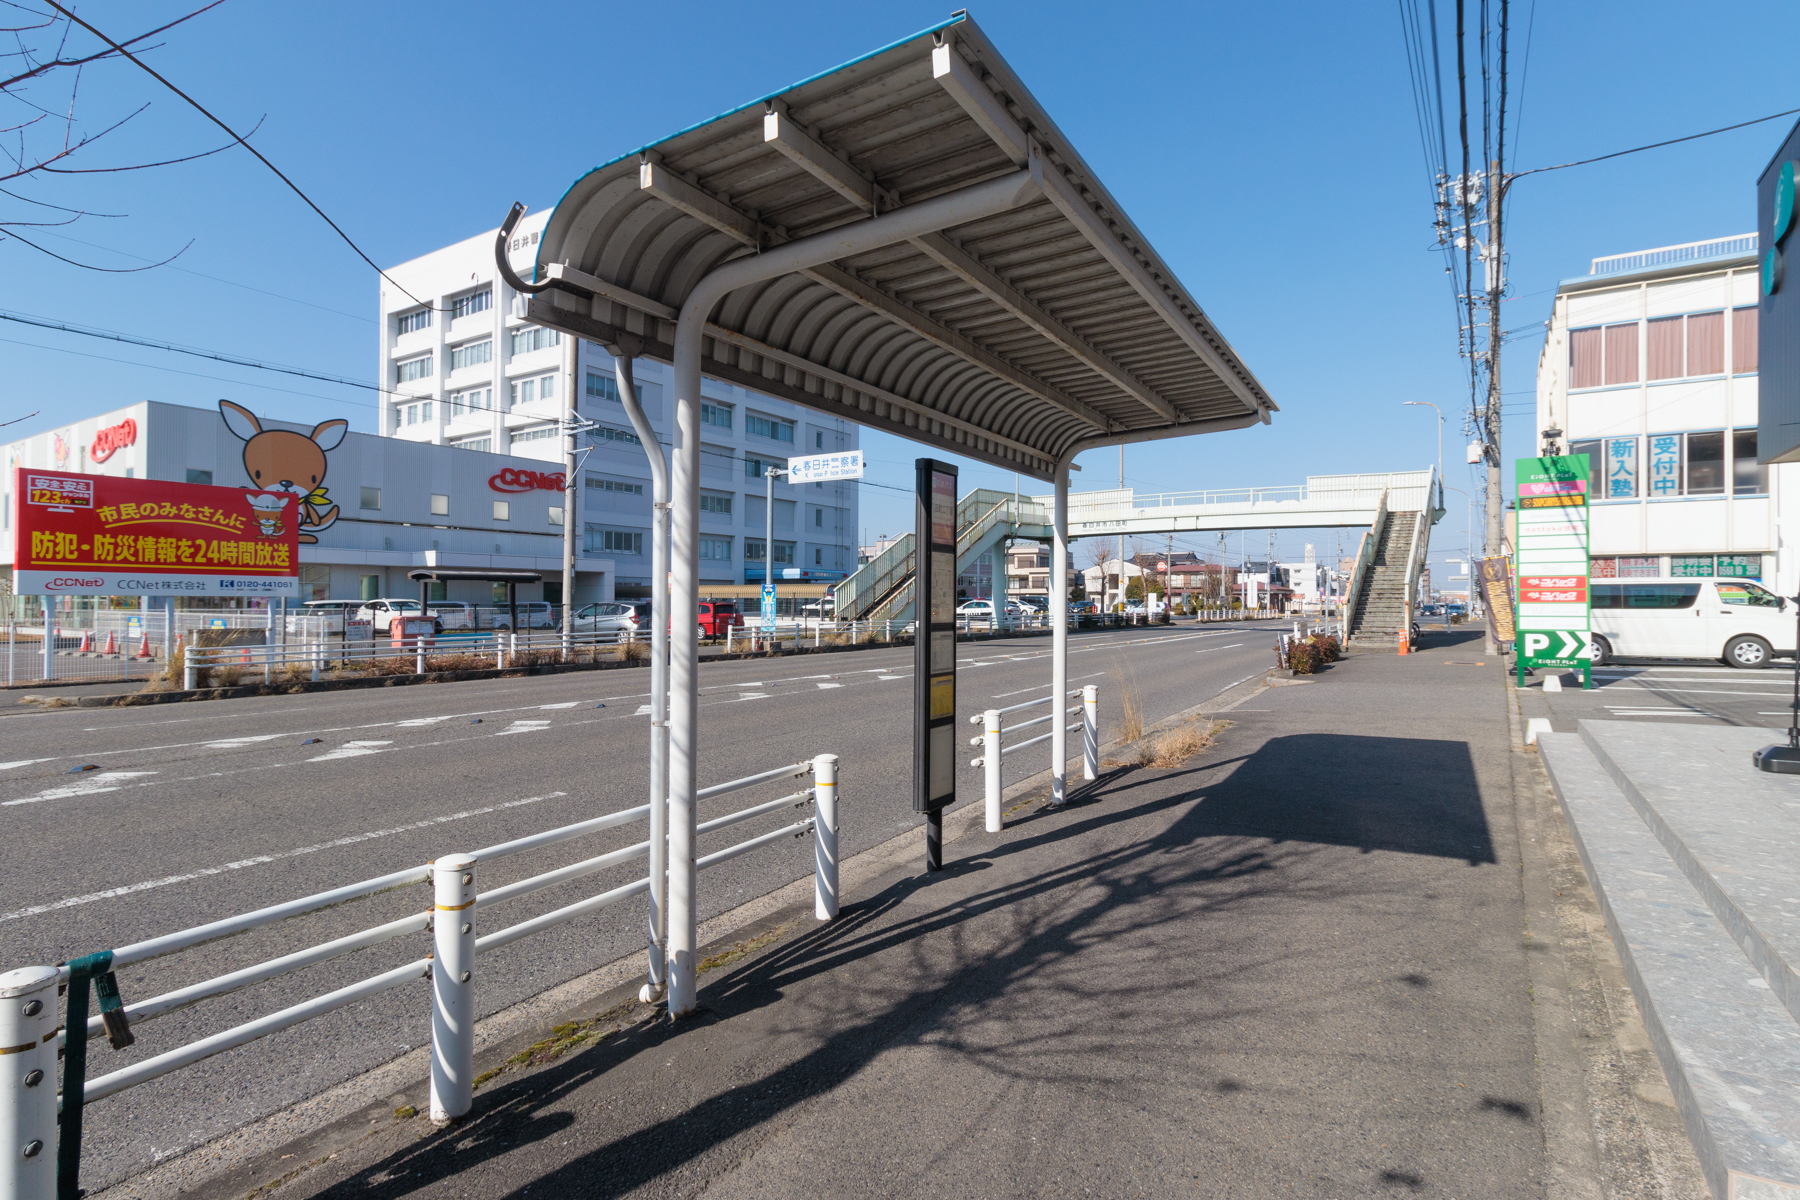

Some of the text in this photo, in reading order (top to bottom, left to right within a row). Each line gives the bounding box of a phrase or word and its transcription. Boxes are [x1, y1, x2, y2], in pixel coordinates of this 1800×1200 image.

[840, 468, 858, 476] Station
[1610, 439, 1635, 497] 新入塾
[1652, 436, 1677, 495] 受付中
[498, 468, 567, 492] CCNet
[95, 502, 247, 529] 市民のみなさんに
[32, 530, 290, 566] 防犯・防災情報を24時間放送
[52, 577, 103, 588] CCNet
[1672, 566, 1713, 577] 受付中
[117, 579, 207, 590] CCNet株式会社
[1524, 633, 1550, 657] P
